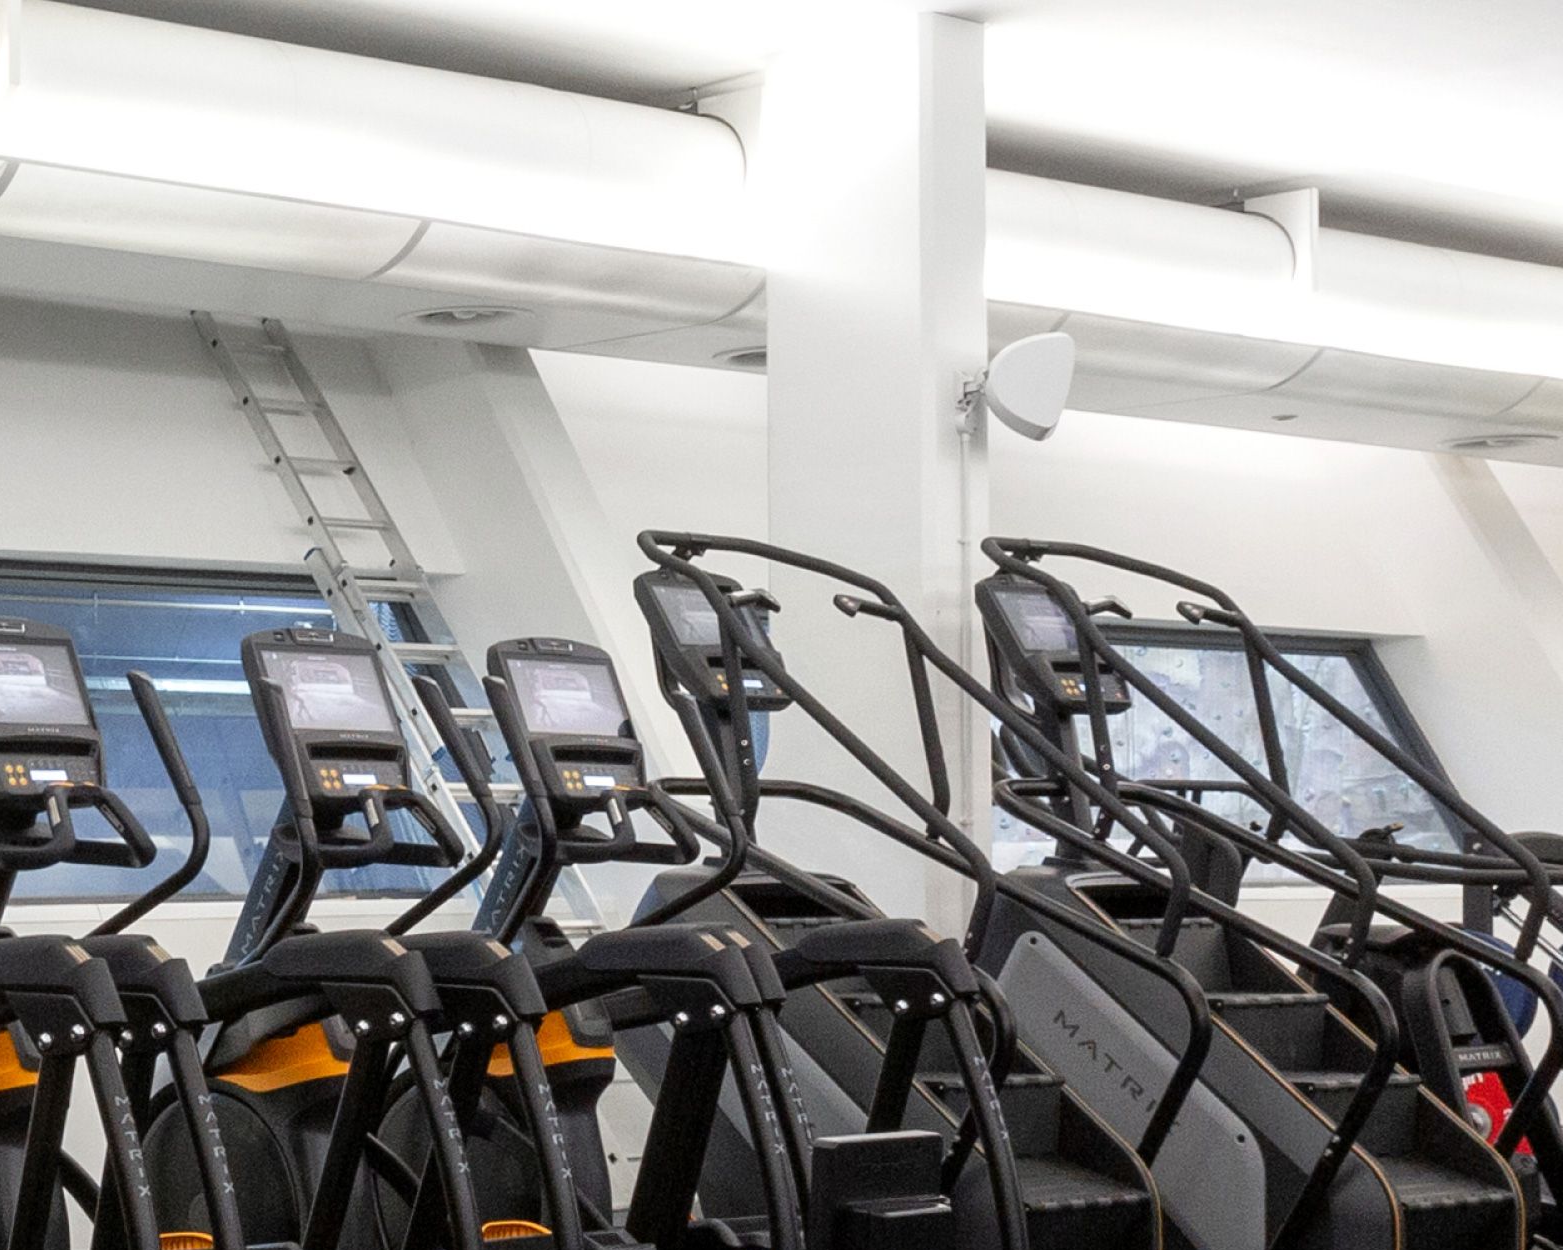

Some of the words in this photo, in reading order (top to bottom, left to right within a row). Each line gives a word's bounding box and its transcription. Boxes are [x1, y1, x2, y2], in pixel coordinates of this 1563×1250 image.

[241, 851, 285, 955] MATRIX
[1053, 1010, 1179, 1127] MATRI
[1458, 1051, 1502, 1061] MATRIX
[114, 1095, 151, 1198] MATRIX
[199, 1094, 235, 1195] MATRIX
[432, 1078, 471, 1175] MATRIX
[537, 1082, 573, 1179] MATRIX
[750, 1063, 786, 1155] MATRIX
